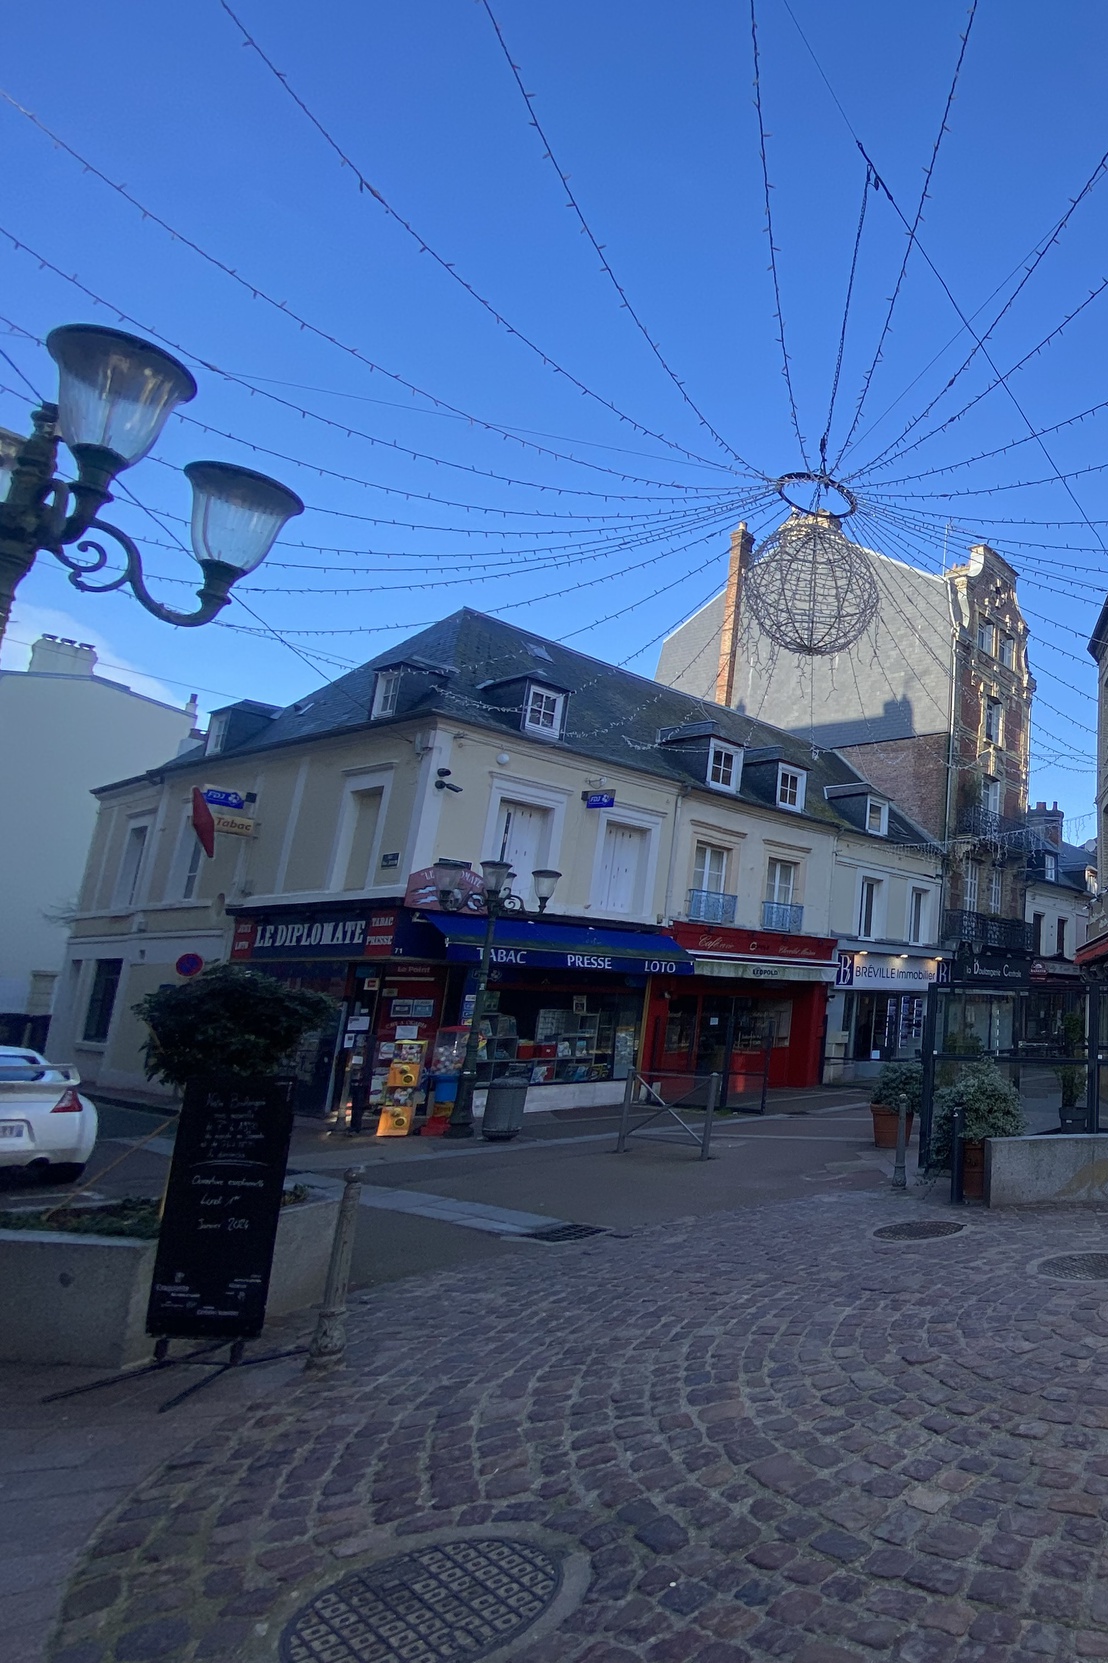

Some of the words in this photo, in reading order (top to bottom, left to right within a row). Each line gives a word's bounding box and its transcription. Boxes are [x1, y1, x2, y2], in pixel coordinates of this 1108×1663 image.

[207, 791, 226, 800] FDJ
[216, 817, 252, 832] Tabac
[371, 917, 394, 928] TABAC
[254, 925, 274, 947] LE
[274, 920, 366, 946] DIPLOMATE
[366, 936, 394, 947] PRESSE
[476, 947, 527, 964] TABAC
[567, 954, 613, 970] PRESSE
[644, 960, 676, 974] LOTO
[408, 966, 431, 974] Point
[855, 965, 896, 980] BRÉVILLE
[896, 968, 936, 981] Immobilier
